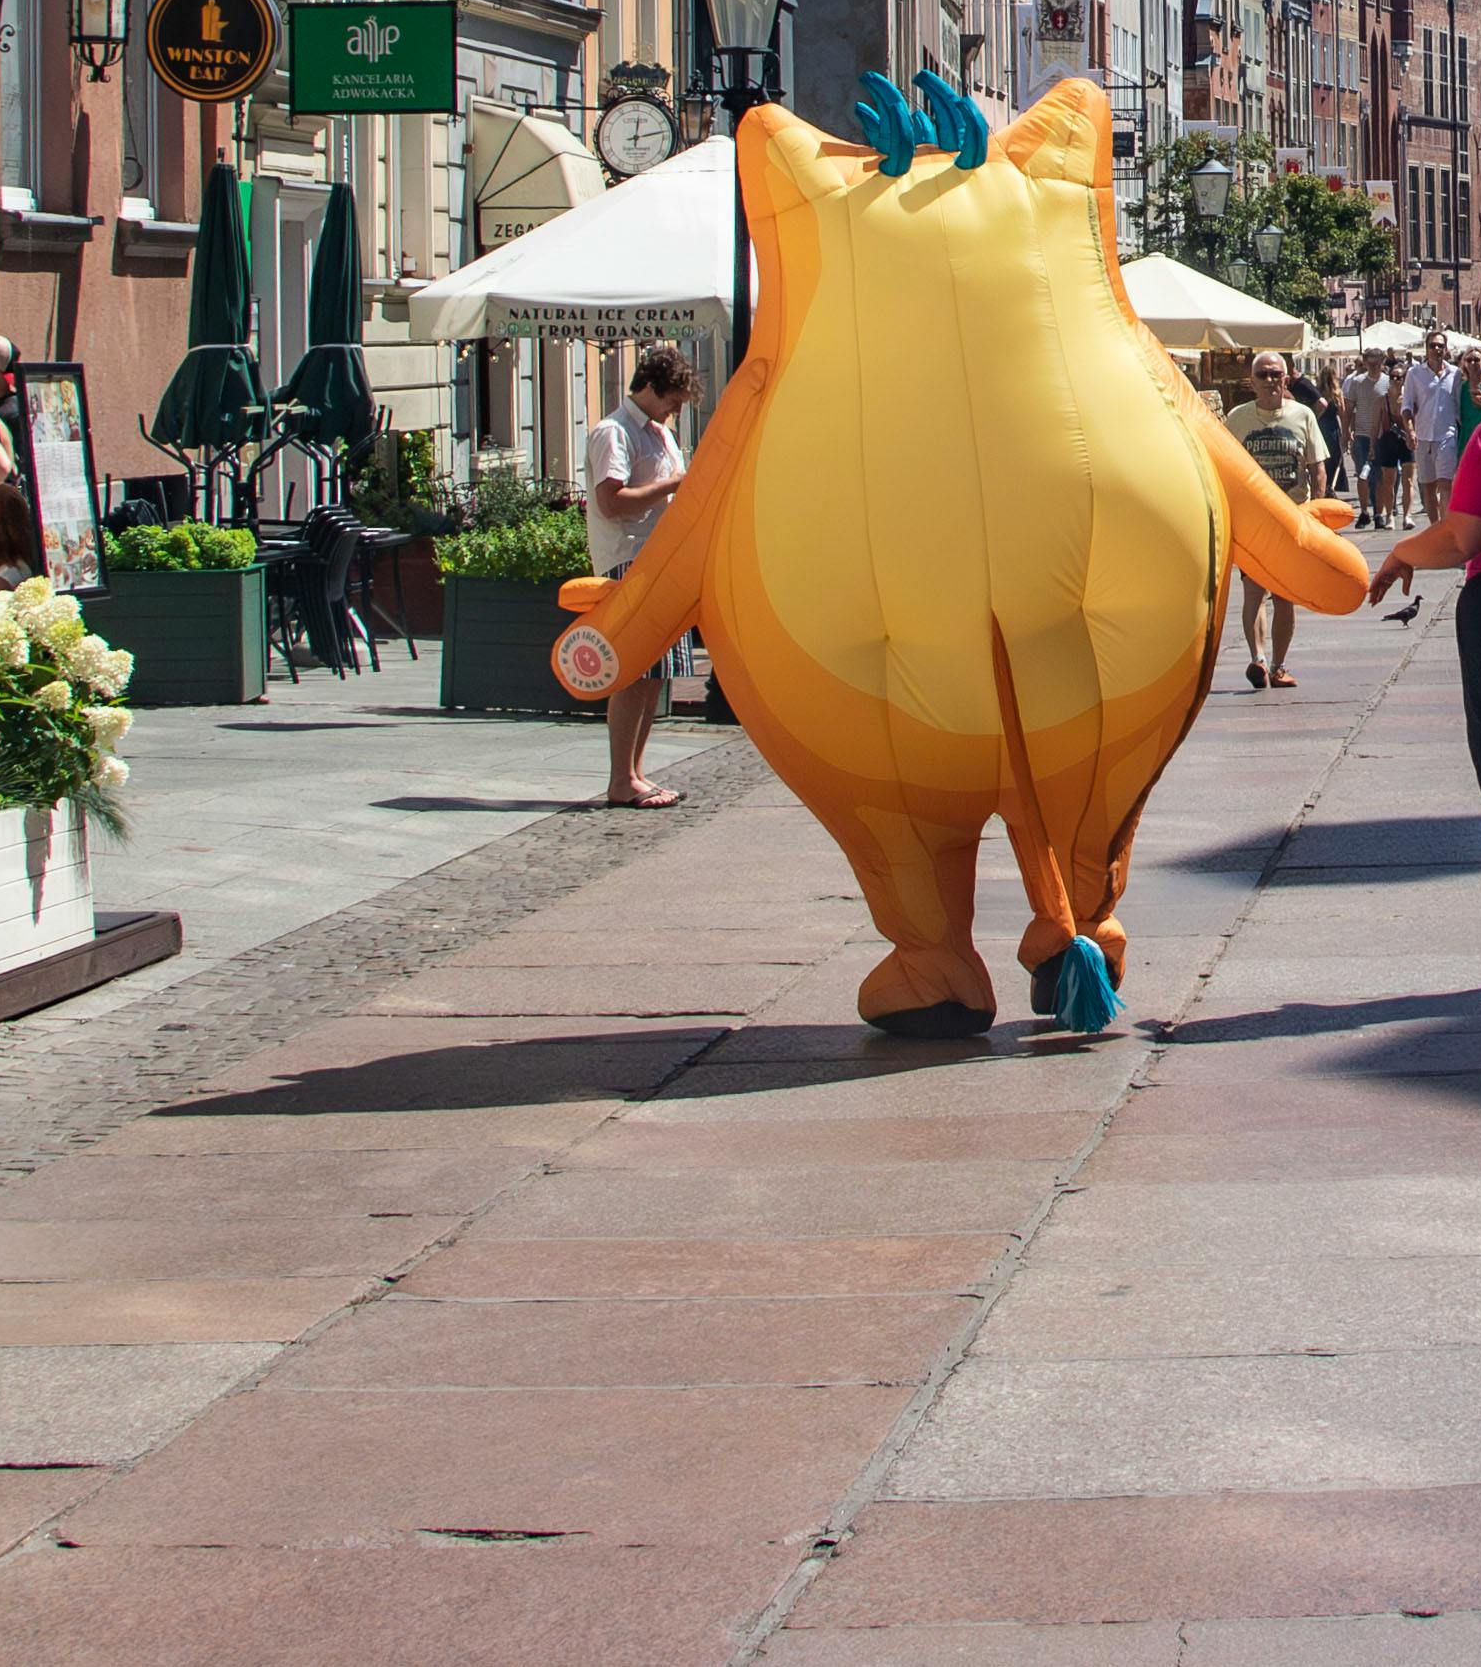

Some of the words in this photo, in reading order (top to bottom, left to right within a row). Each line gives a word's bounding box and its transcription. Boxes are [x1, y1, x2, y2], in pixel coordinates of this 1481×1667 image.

[167, 47, 251, 64] WINSTON
[189, 66, 227, 81] BAR
[332, 73, 415, 85] KANCELARIA
[332, 87, 416, 99] ADWOKACKA
[509, 308, 588, 321] NATURAL
[598, 308, 625, 321] ICE
[635, 308, 695, 321] CREAM
[538, 325, 585, 338] FROM
[594, 322, 665, 338] GDAŃSK
[1246, 439, 1298, 453] PREMIUM
